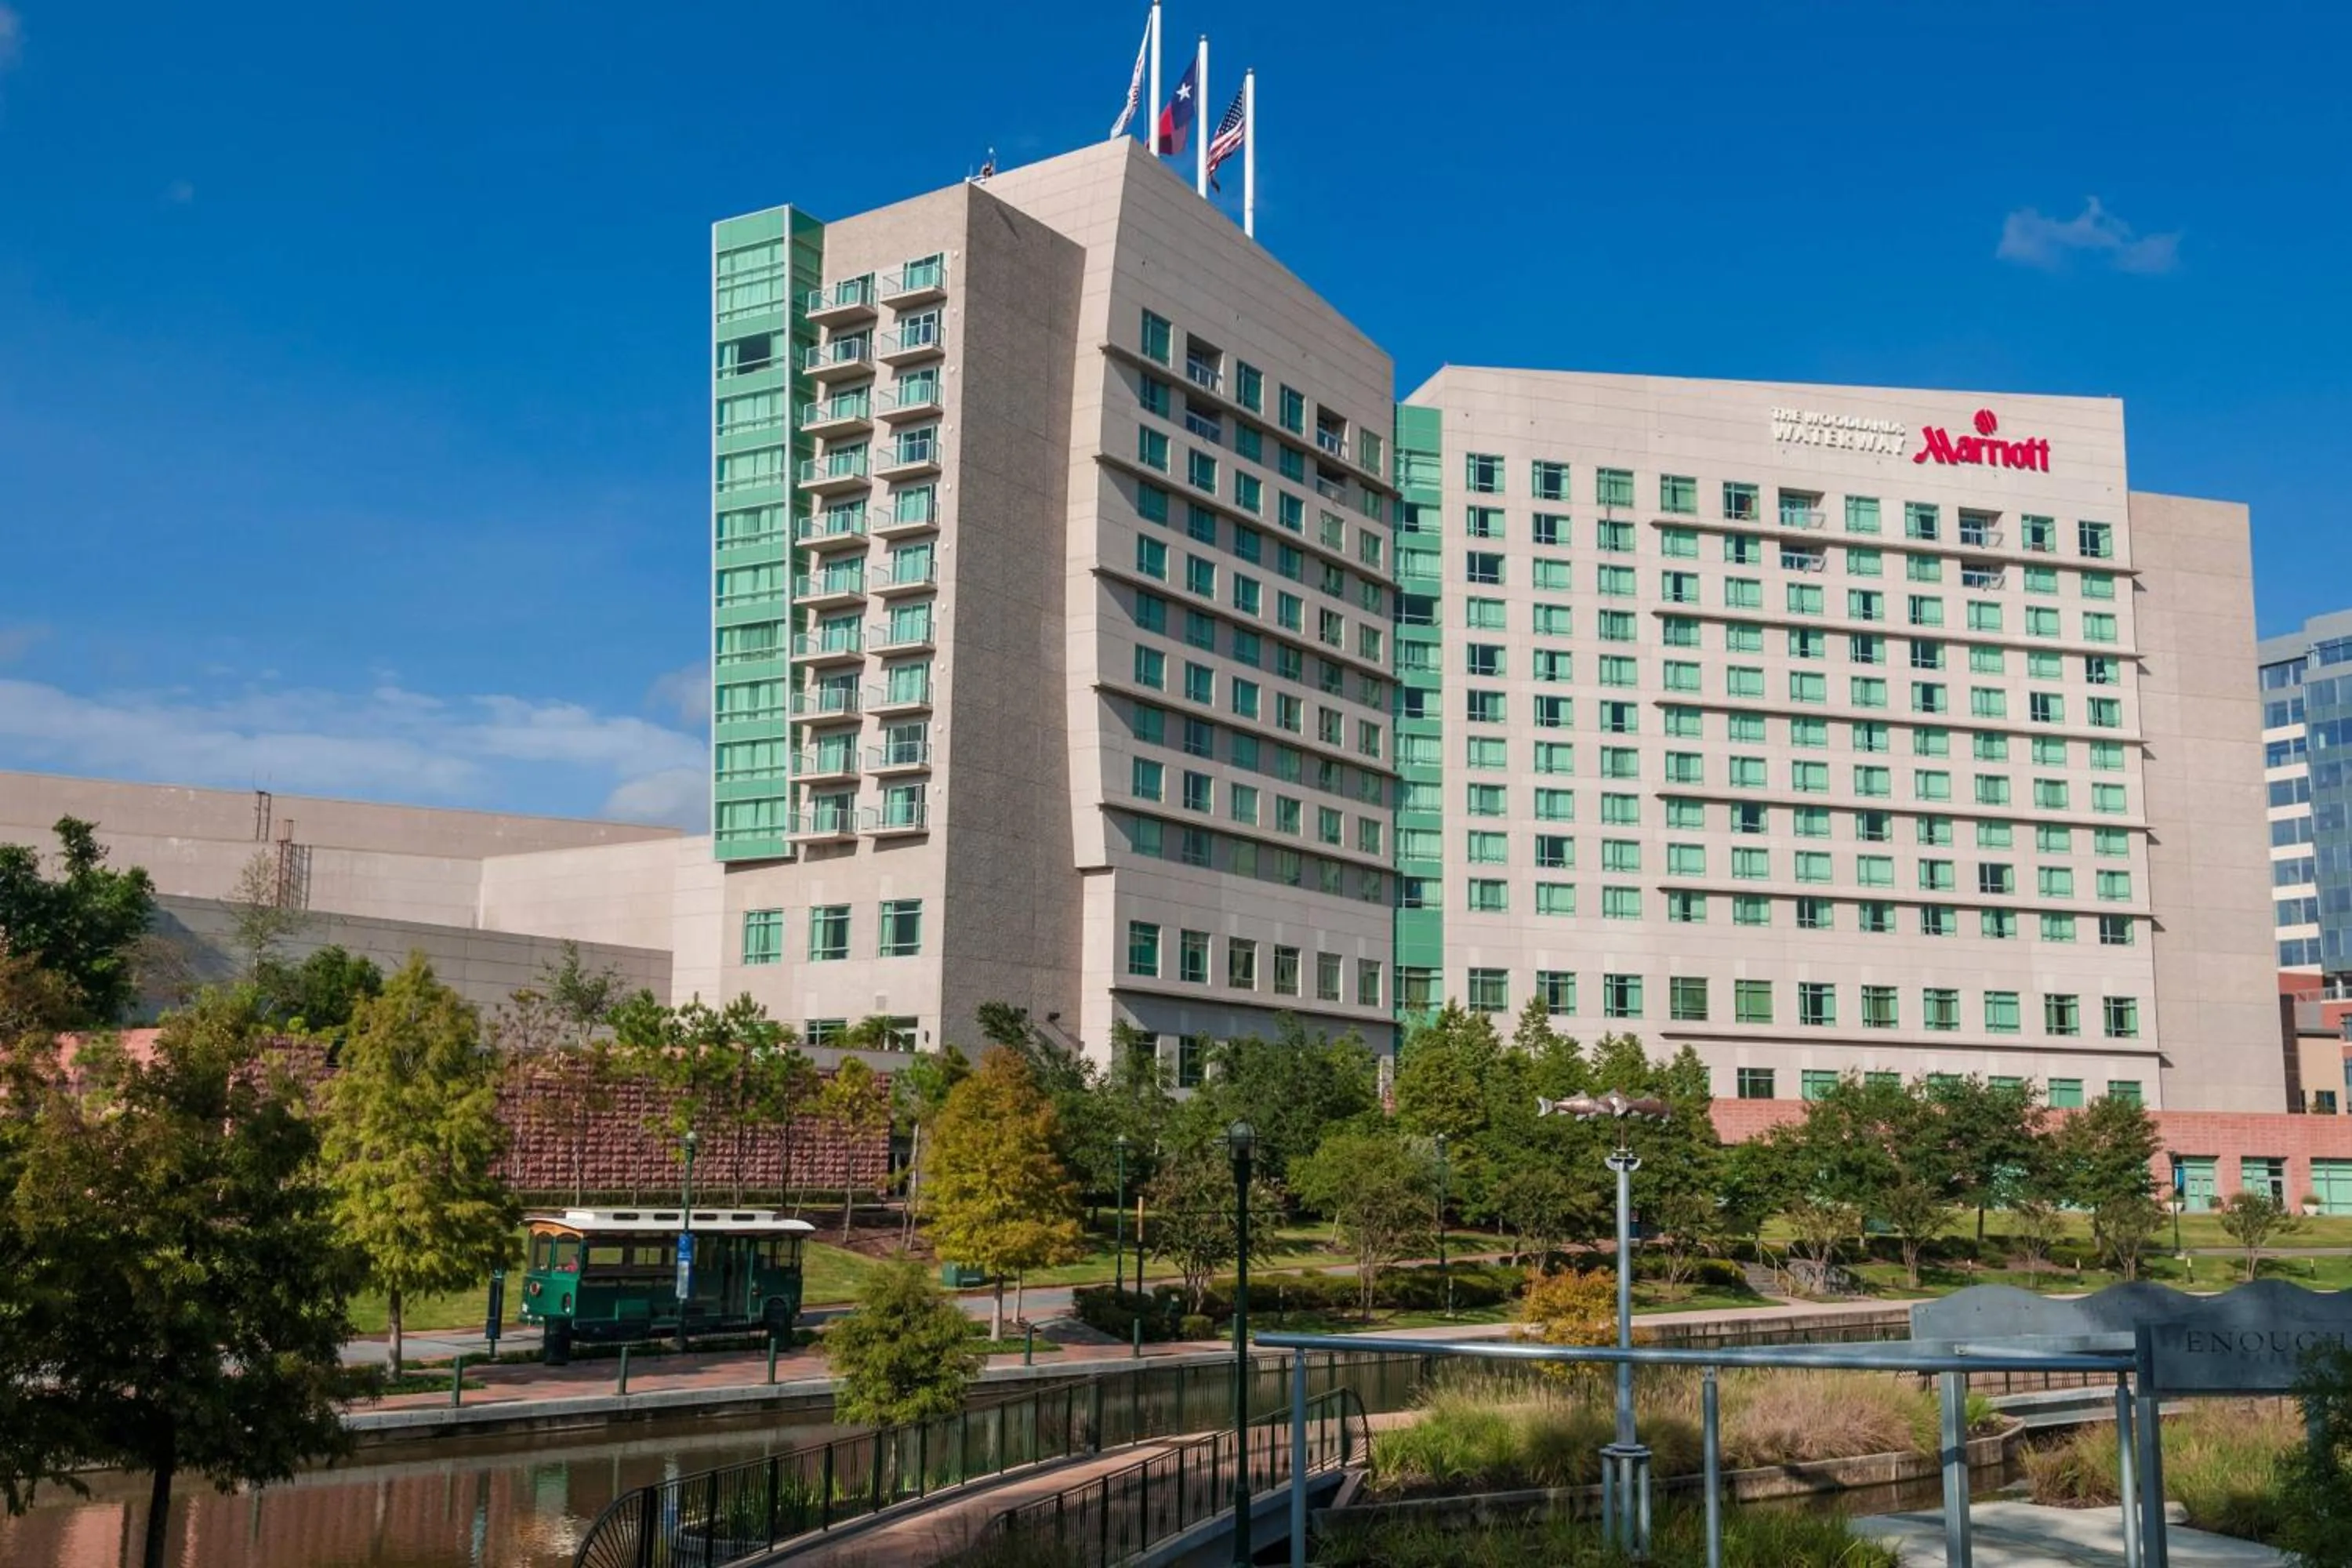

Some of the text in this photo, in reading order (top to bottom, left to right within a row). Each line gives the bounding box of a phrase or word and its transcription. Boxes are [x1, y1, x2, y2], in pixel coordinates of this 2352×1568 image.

[1771, 408, 1907, 437] THE WOODLANDS
[1772, 422, 1907, 456] WATERWAY
[1913, 408, 2050, 473] Marriott
